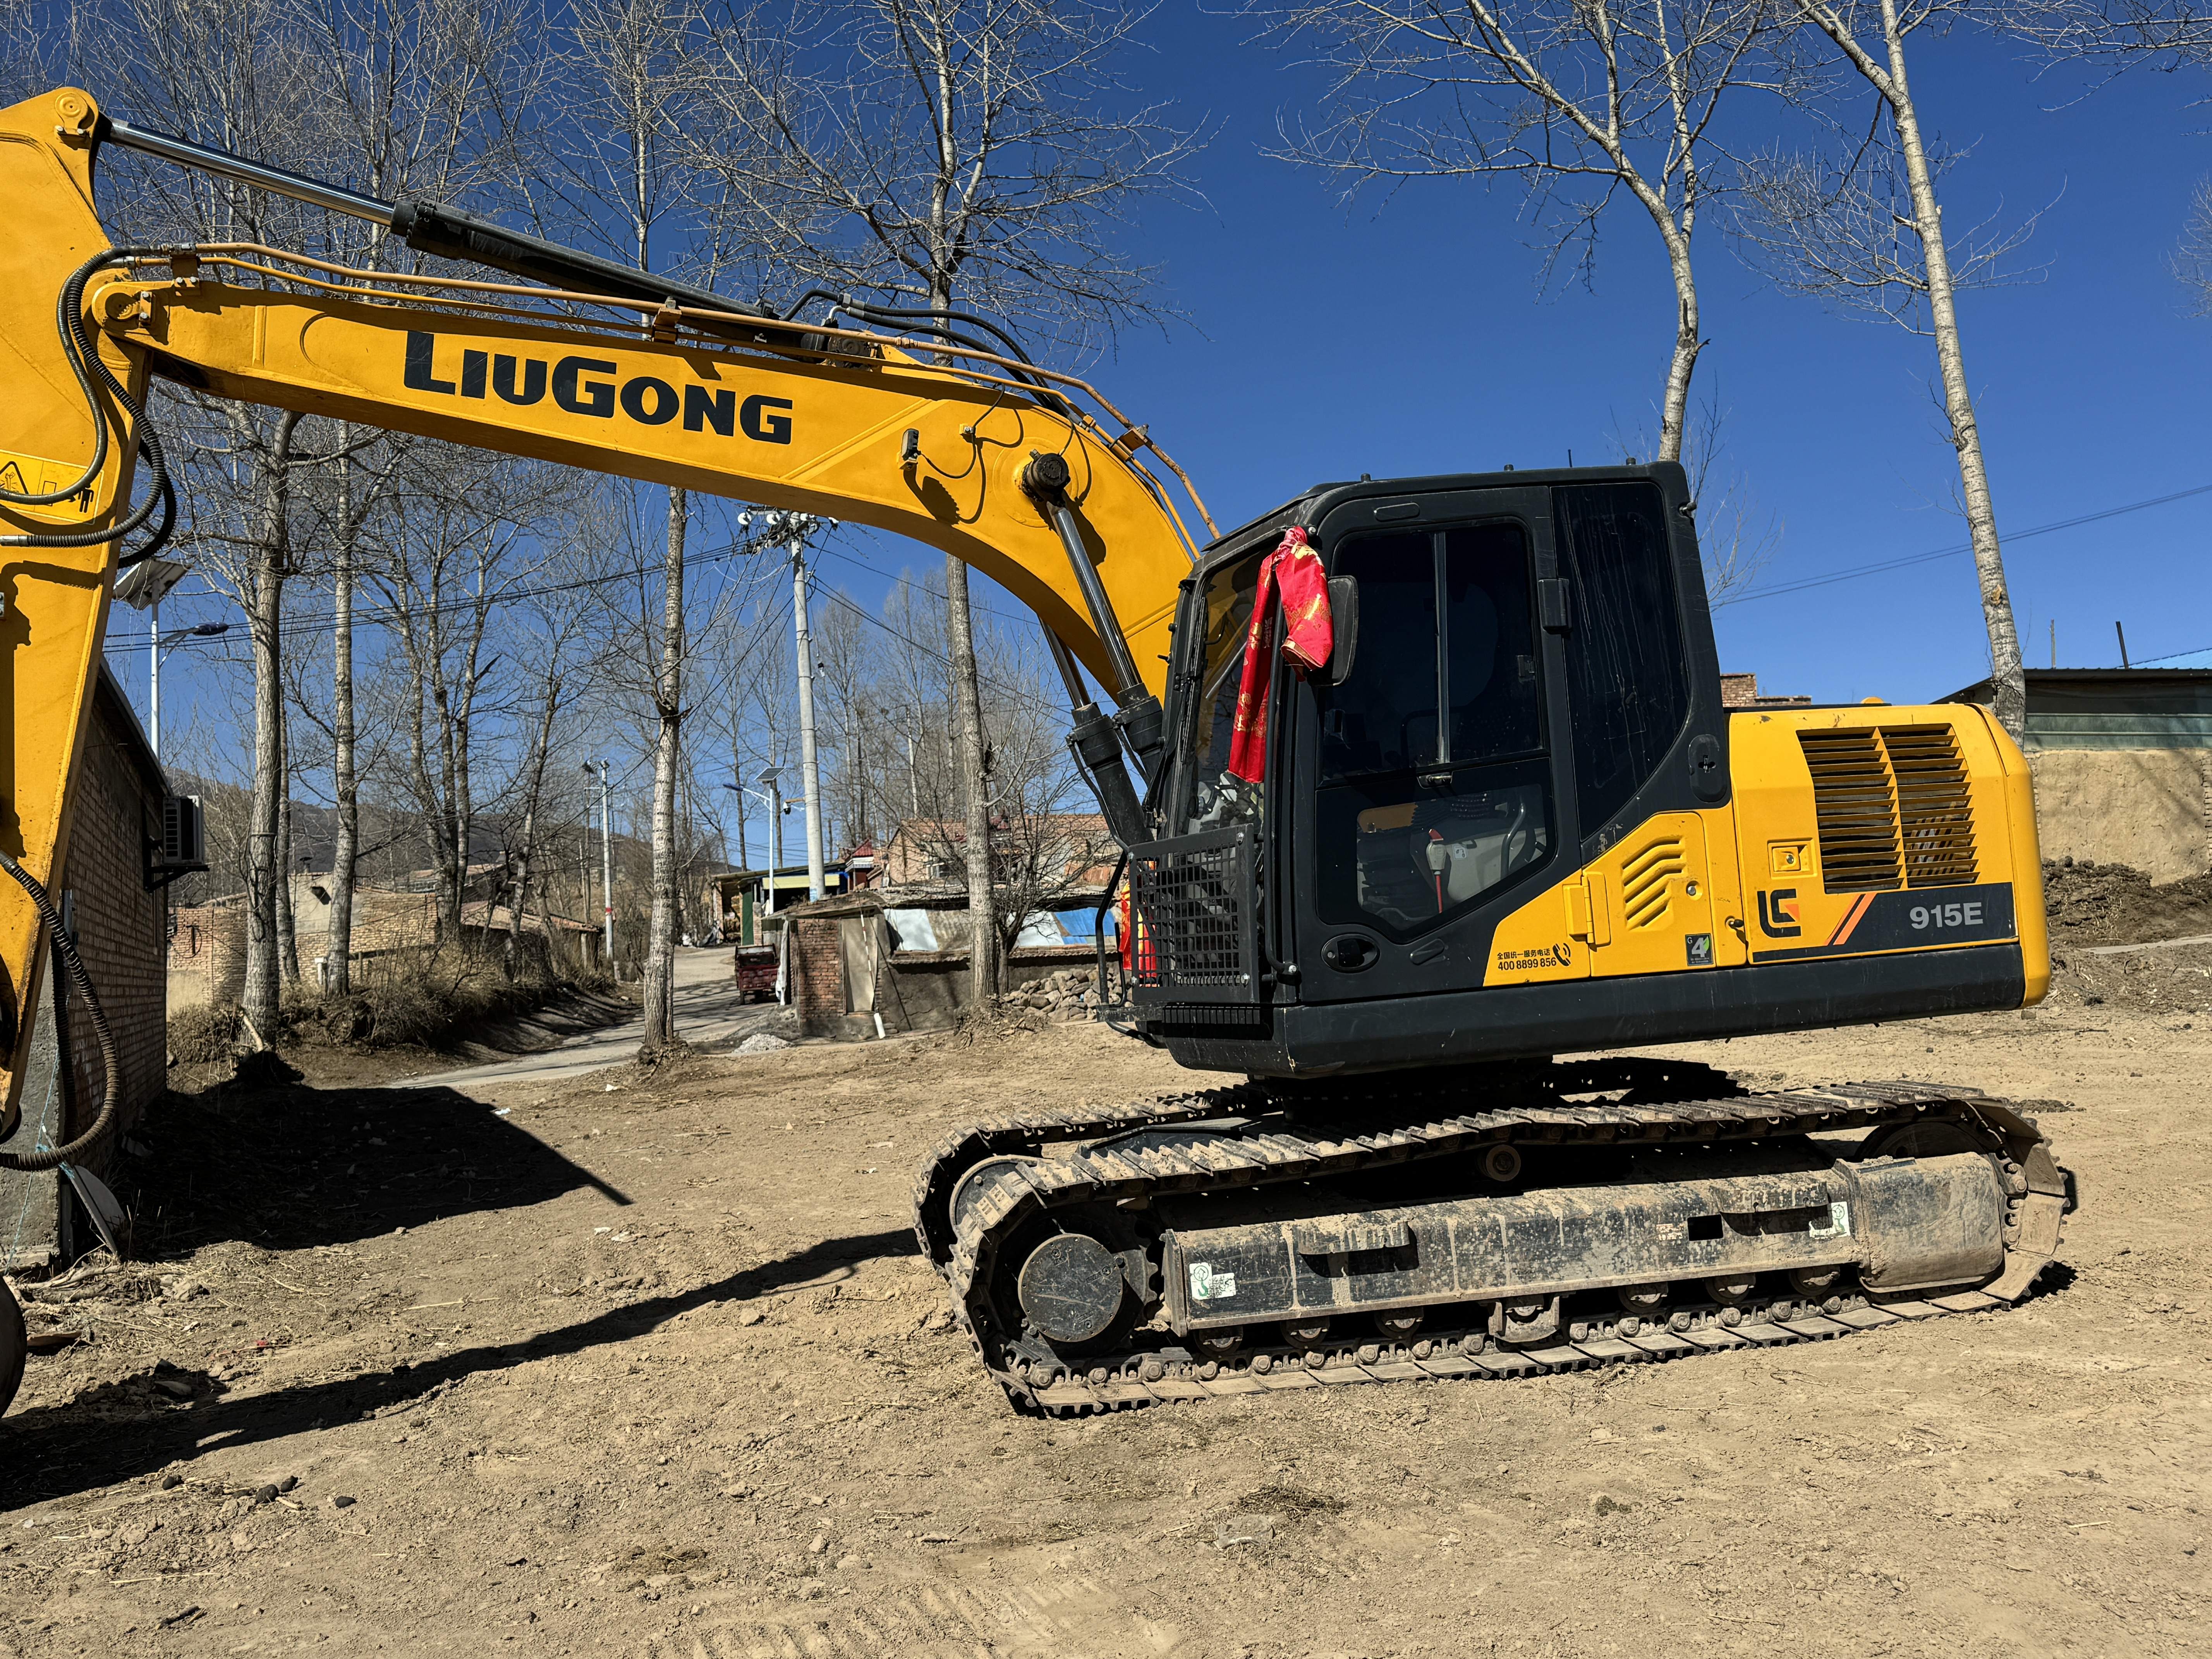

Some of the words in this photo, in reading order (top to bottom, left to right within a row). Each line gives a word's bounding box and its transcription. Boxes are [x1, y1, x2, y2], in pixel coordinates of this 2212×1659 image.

[404, 330, 793, 445] LIUGONG
[1910, 902, 1983, 929] 915E
[1497, 948, 1550, 960] 全国统一服务电话
[1692, 938, 1706, 957] 4
[1498, 961, 1515, 970] 400
[1516, 959, 1538, 969] 8899
[1540, 957, 1556, 967] 856
